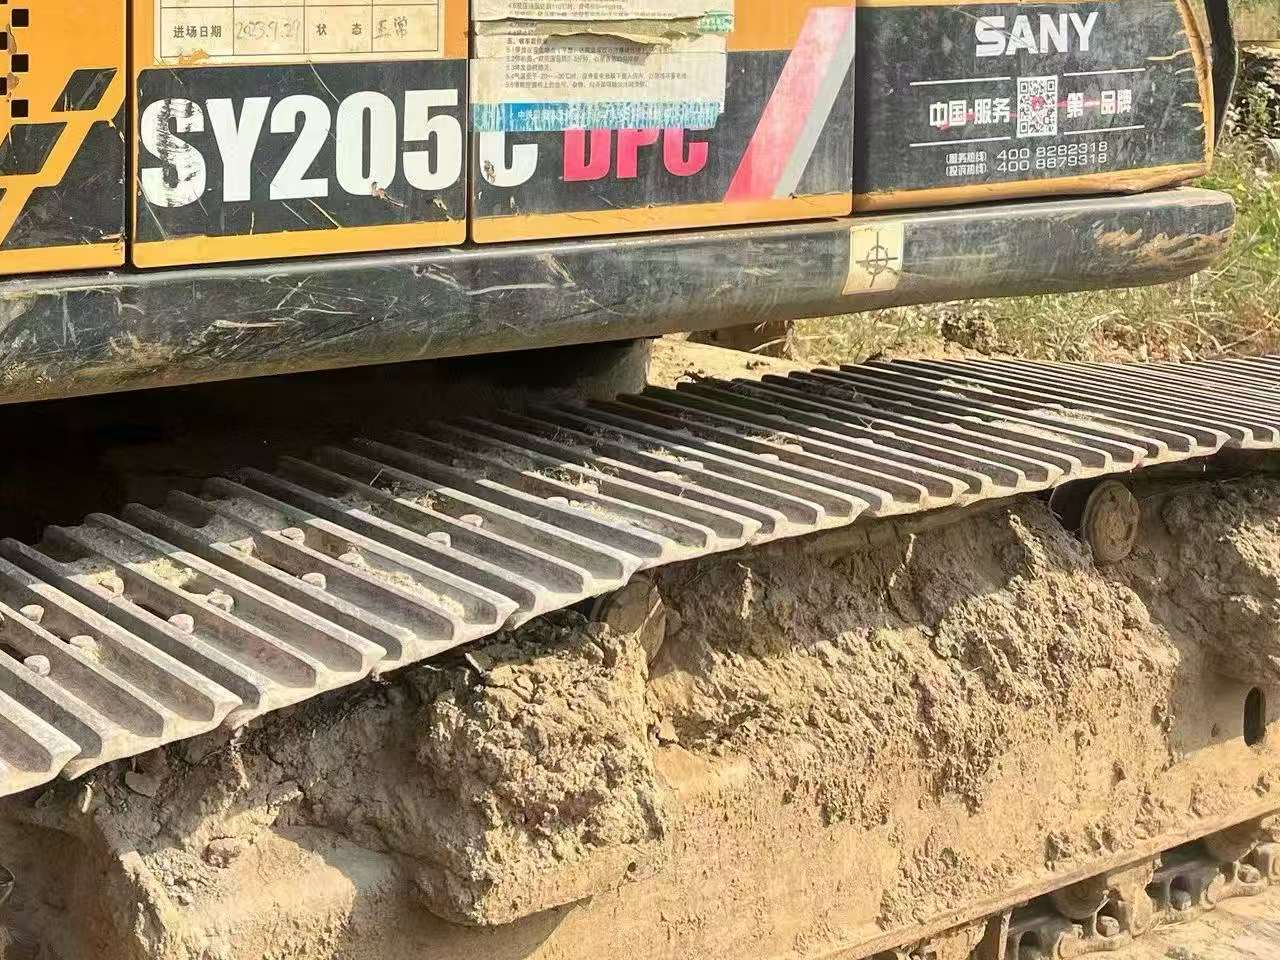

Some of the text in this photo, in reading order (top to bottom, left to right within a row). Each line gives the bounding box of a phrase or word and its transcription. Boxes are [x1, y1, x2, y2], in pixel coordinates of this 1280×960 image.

[173, 24, 222, 39] 进场日期
[975, 11, 1099, 58] SANY
[996, 148, 1030, 161] 400
[1035, 141, 1108, 158] 8282318
[996, 160, 1030, 173] 400
[1035, 153, 1107, 170] 8879318
